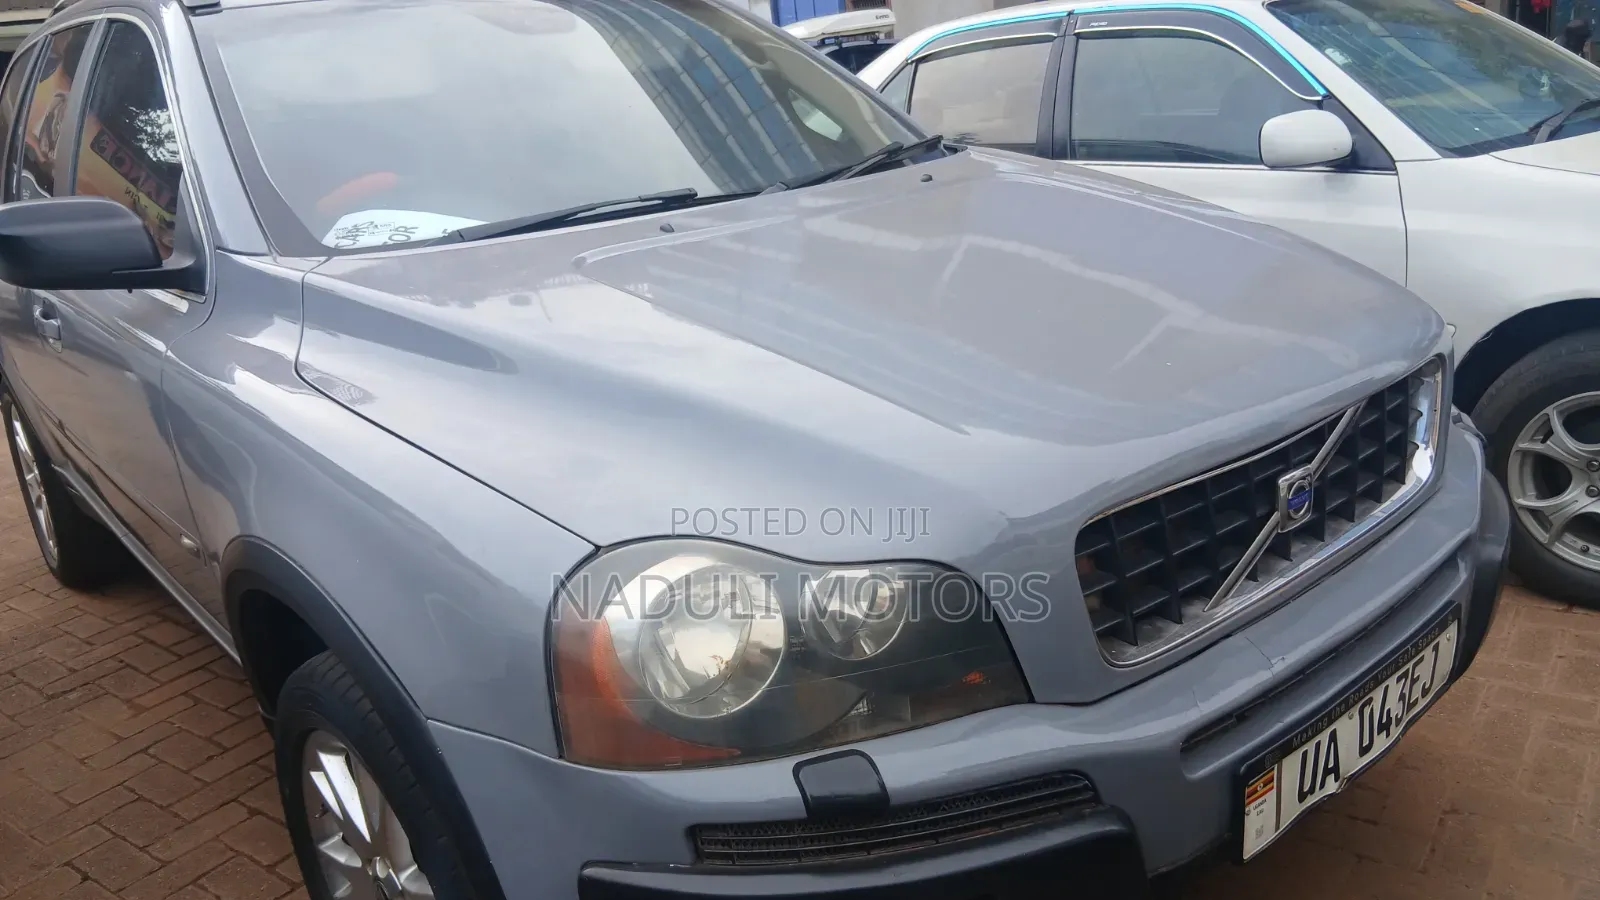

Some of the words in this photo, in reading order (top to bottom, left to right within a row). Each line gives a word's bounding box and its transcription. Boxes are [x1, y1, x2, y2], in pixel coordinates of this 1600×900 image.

[386, 225, 419, 243] OR
[1292, 719, 1329, 748] Making
[1331, 702, 1346, 719] the
[1348, 681, 1375, 706] Roads
[1377, 663, 1396, 680] Your
[1398, 645, 1417, 666] Safe
[1418, 628, 1439, 650] Space
[1297, 727, 1341, 804] UA
